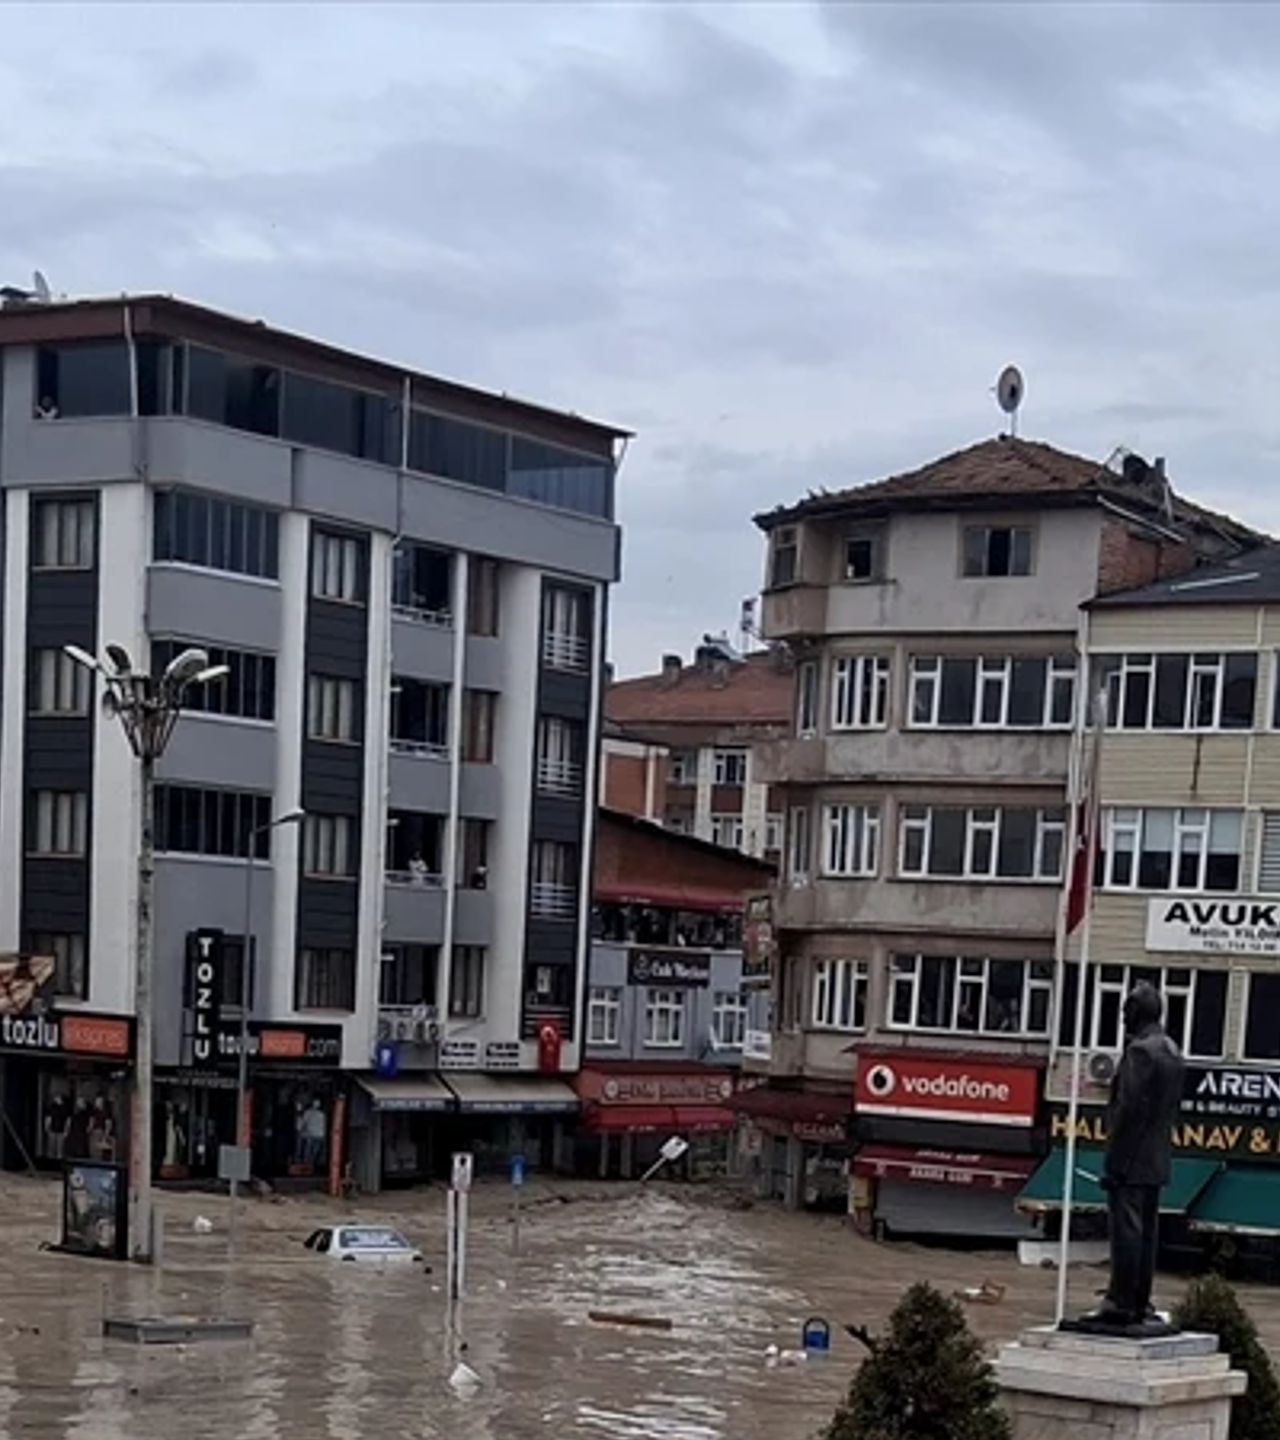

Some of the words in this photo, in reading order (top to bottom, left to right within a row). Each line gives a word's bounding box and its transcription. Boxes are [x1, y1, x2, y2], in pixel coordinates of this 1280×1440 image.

[194, 937, 214, 1059] TOZLU
[2, 1014, 58, 1047] tozlu
[902, 1074, 1010, 1101] vodafone
[1208, 1102, 1262, 1115] BEAUTY
[1171, 1122, 1242, 1149] NAV
[1250, 1127, 1270, 1153] &
